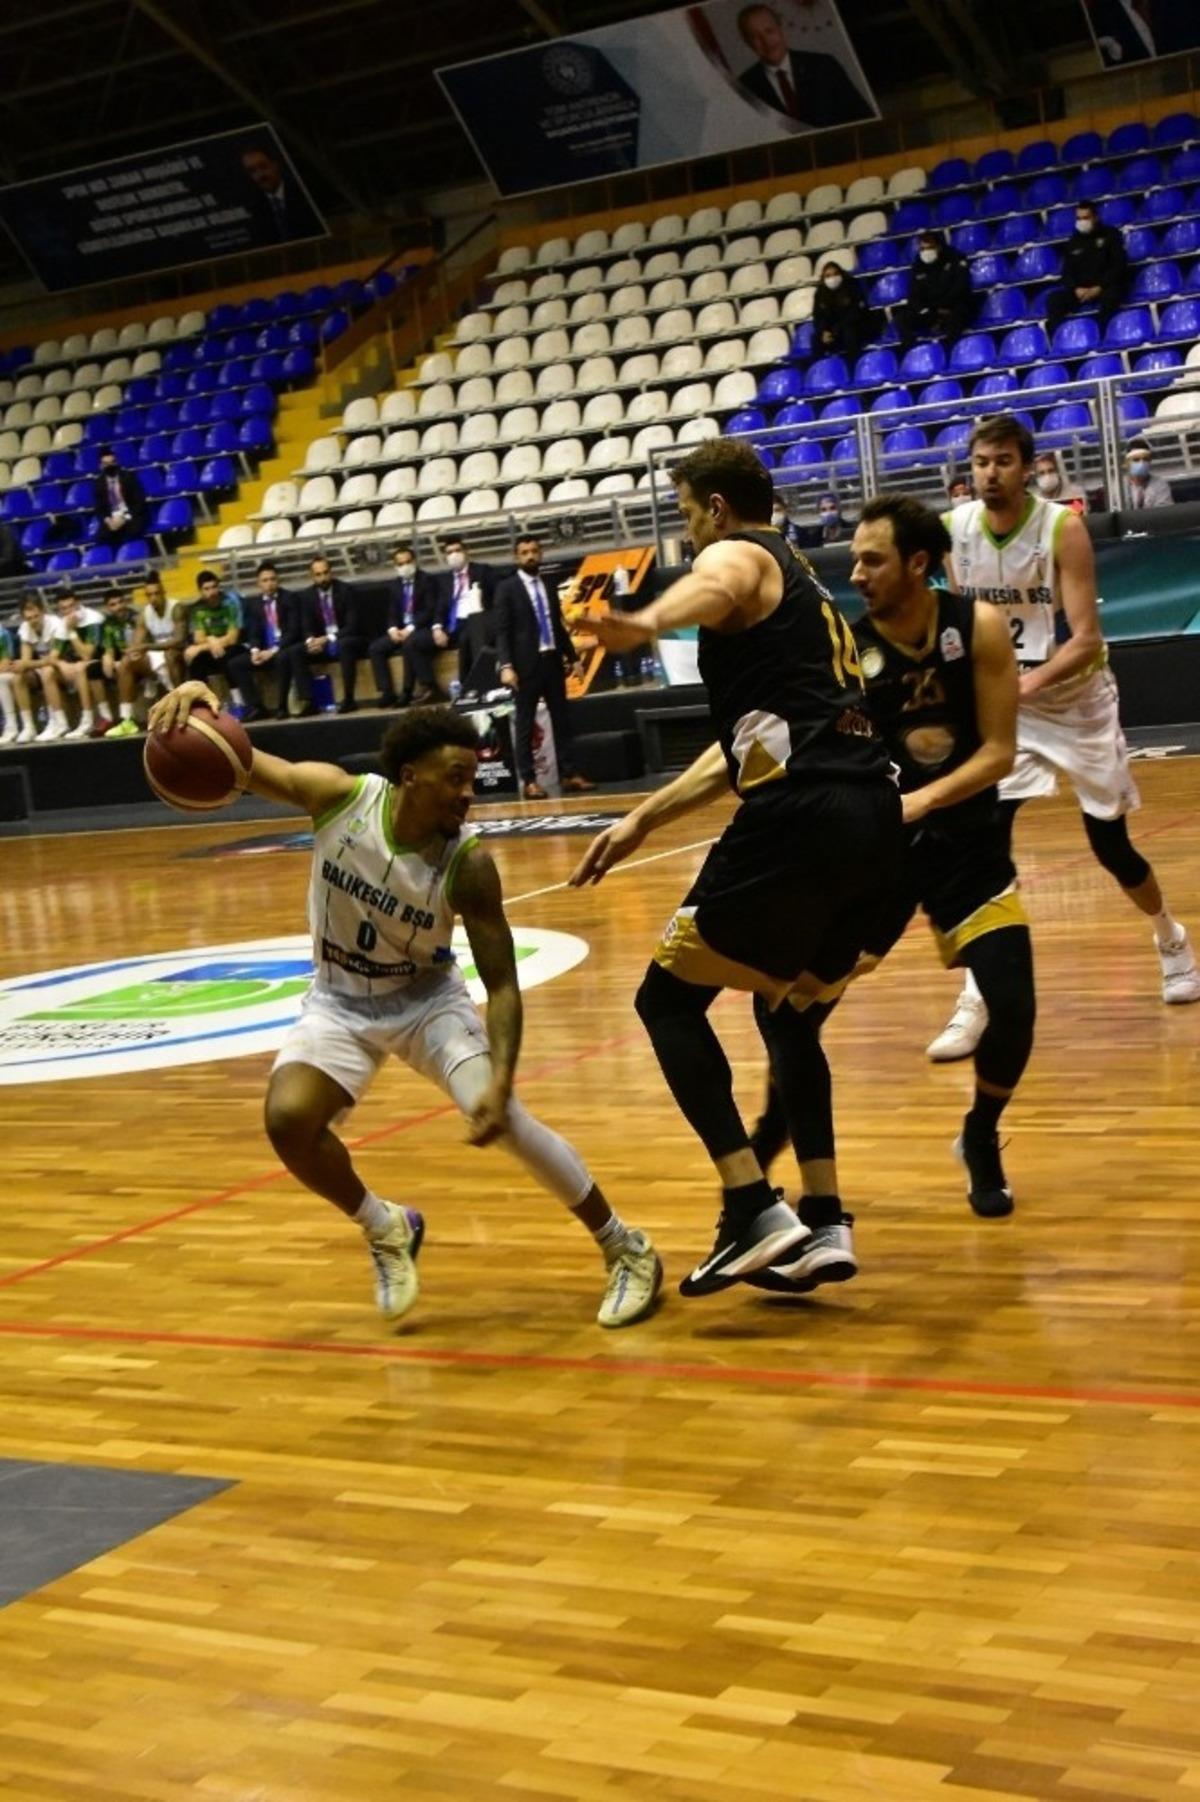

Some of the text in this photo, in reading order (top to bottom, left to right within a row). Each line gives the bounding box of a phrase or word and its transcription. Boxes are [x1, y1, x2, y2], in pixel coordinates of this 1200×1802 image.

[821, 601, 866, 696] 14
[322, 860, 435, 930] BALIKESİR BSB
[357, 920, 377, 952] 0
